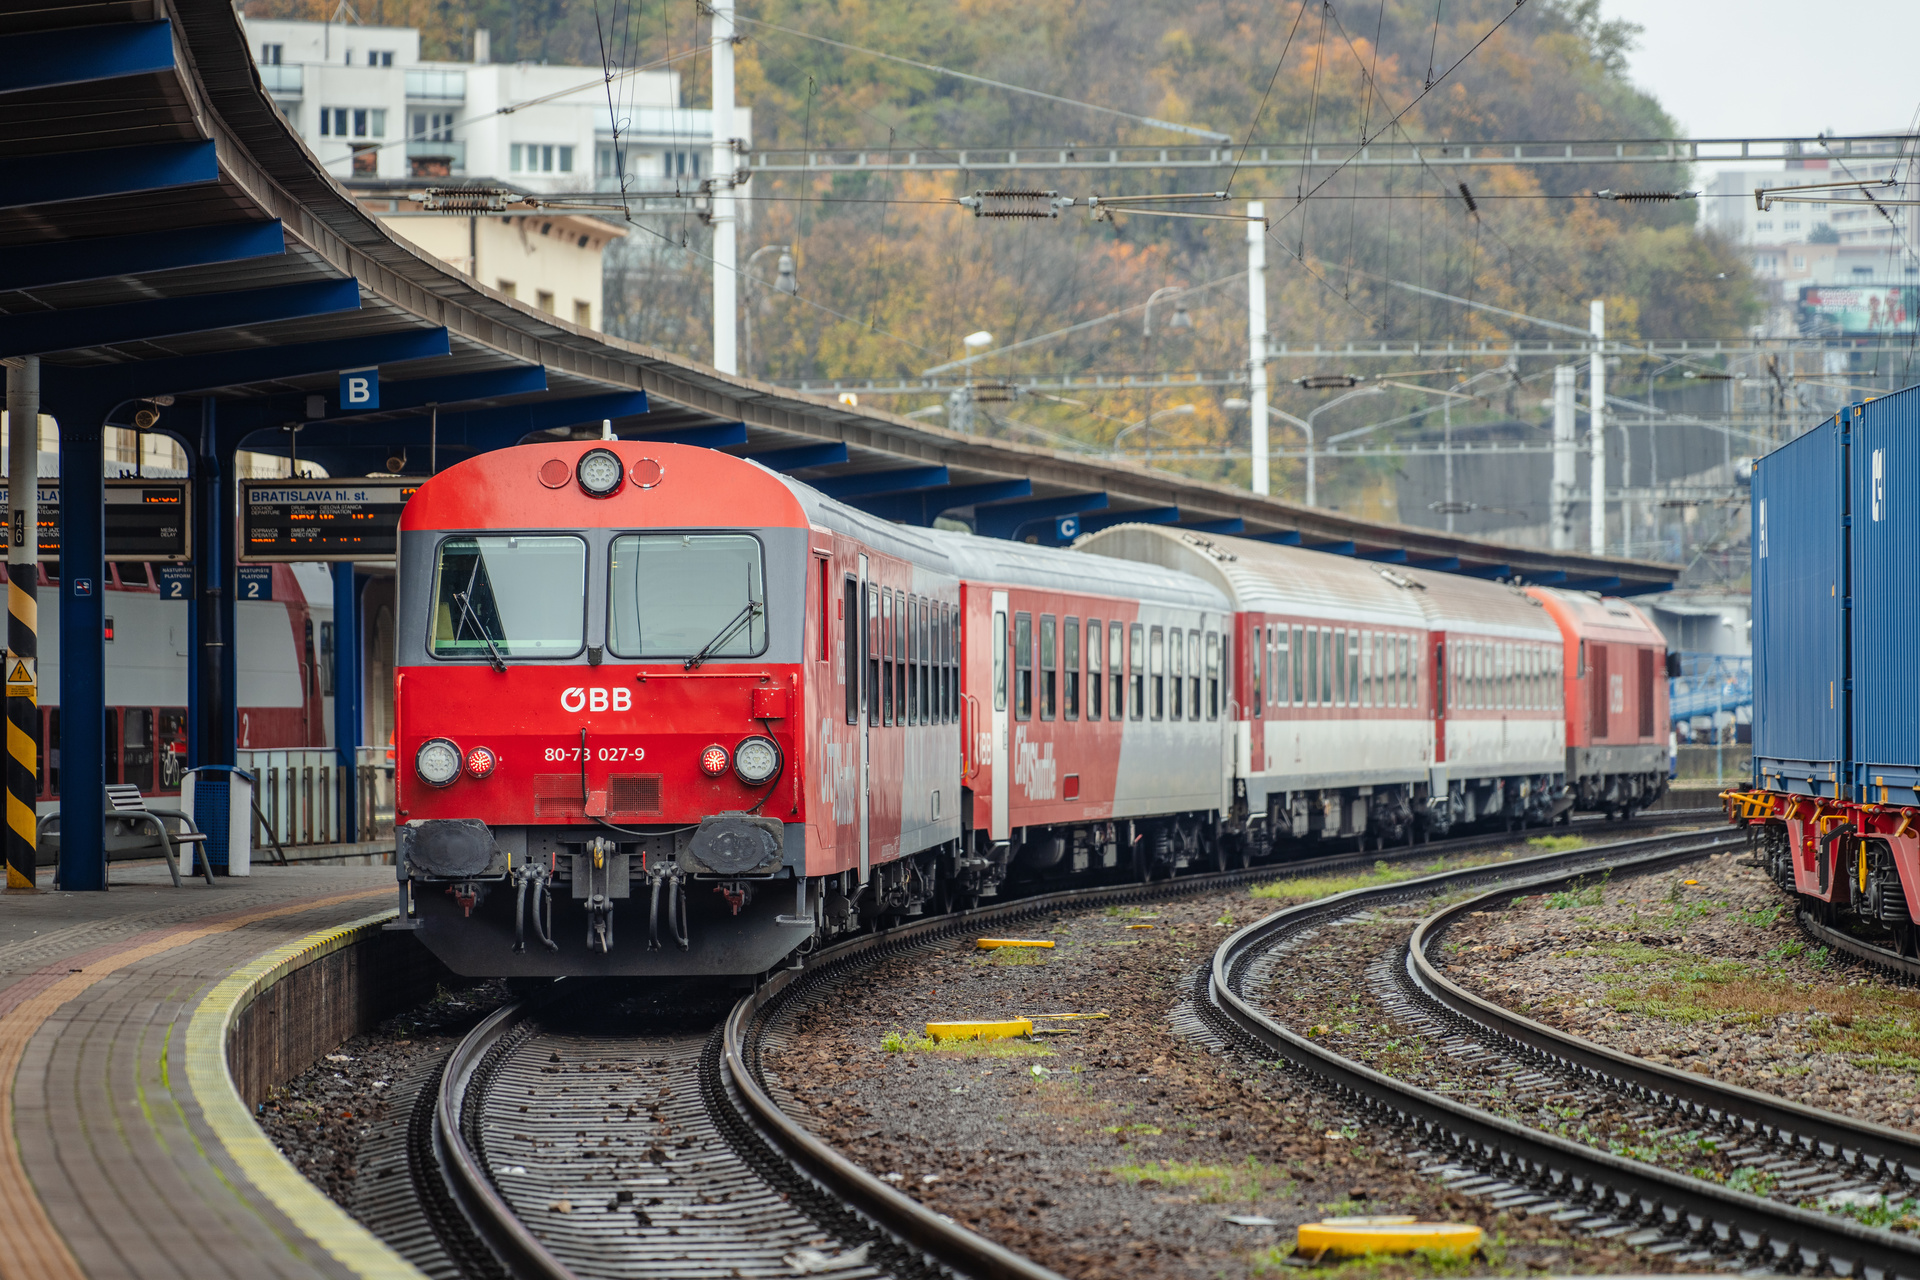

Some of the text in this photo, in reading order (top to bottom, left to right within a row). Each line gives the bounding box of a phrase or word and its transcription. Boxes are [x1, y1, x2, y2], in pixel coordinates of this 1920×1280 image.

[349, 378, 370, 403] B
[252, 491, 368, 502] BRATISLAVA hl. st.
[1061, 520, 1076, 537] C
[170, 581, 182, 597] 2
[247, 582, 259, 598] 2
[561, 687, 632, 713] ÖBB
[243, 713, 249, 747] 2
[544, 748, 645, 761] 80-73 027-9
